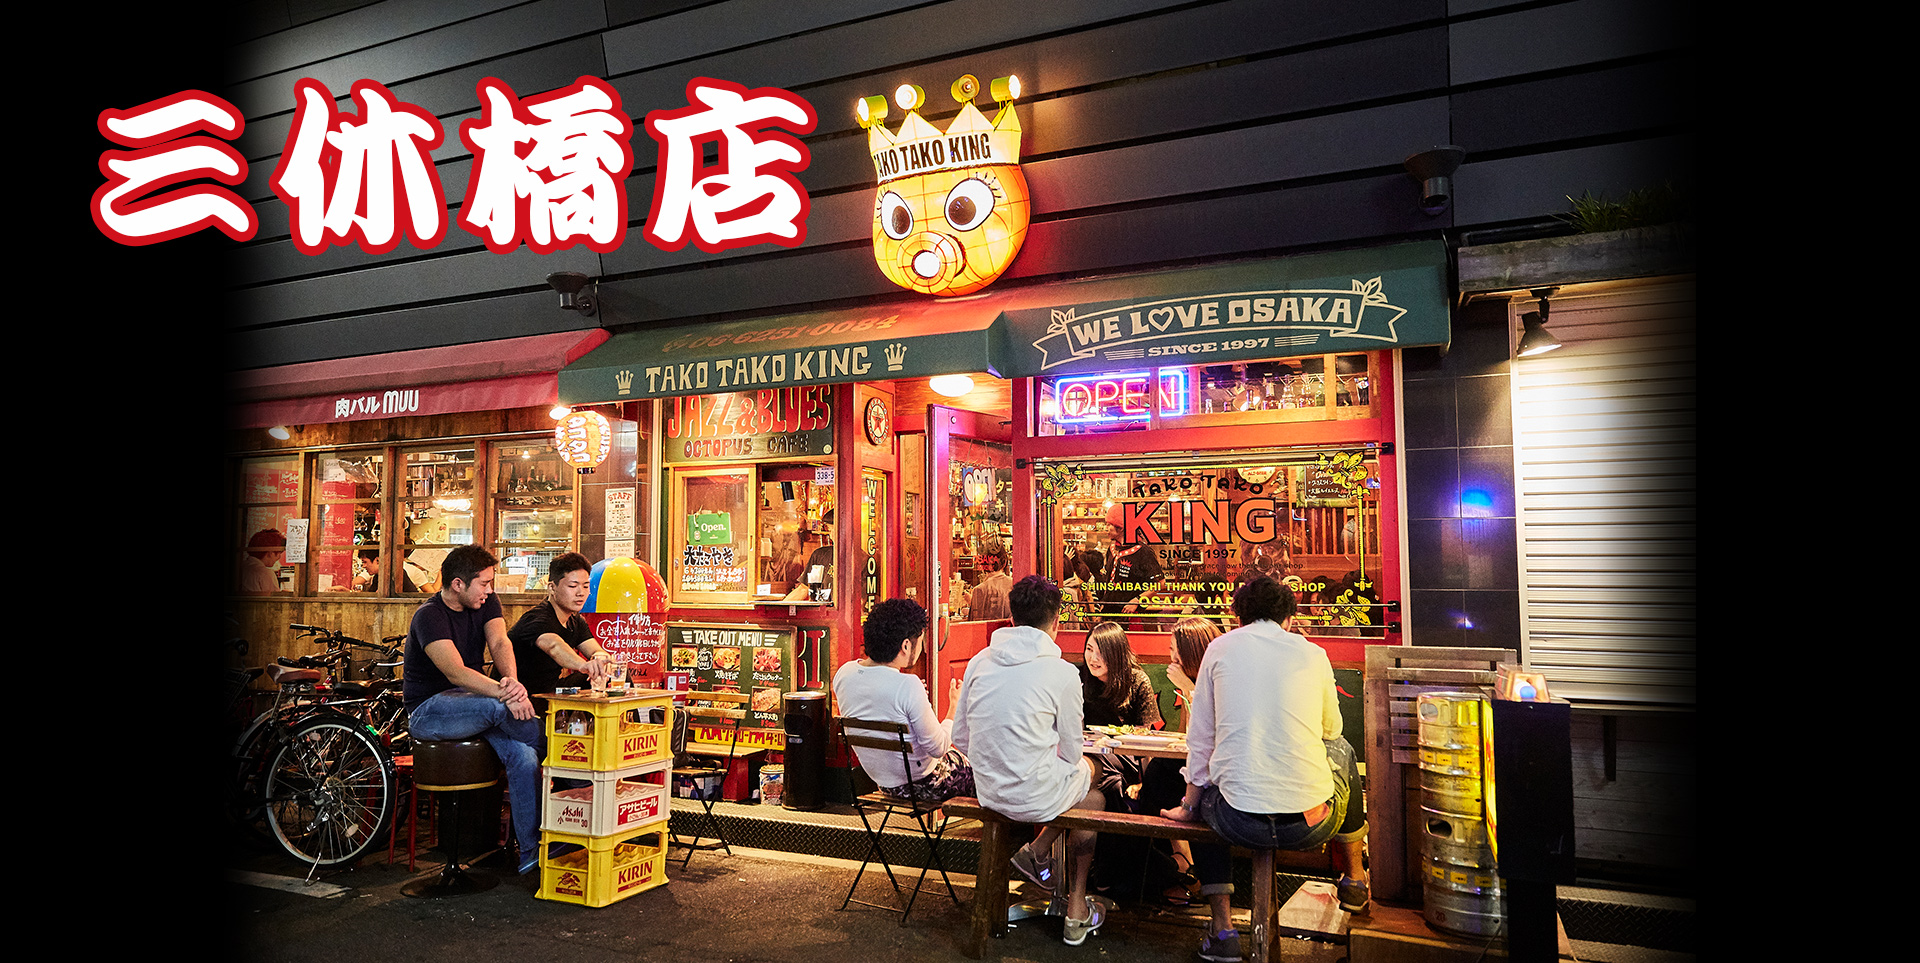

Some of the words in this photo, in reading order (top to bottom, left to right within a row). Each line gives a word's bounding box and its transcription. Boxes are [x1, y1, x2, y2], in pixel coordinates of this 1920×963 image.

[899, 139, 946, 172] TAKO
[948, 132, 992, 164] KING
[1071, 314, 1123, 346] WE
[1227, 296, 1354, 325] OSAKA
[1147, 340, 1218, 358] SINCE
[1220, 336, 1271, 352] 1997
[645, 362, 710, 394] TAKO
[715, 353, 787, 388] TAKO
[793, 345, 872, 382] KING
[335, 396, 381, 419] 肉バル
[382, 389, 420, 414] MUU
[1062, 376, 1176, 418] OPEN
[554, 425, 571, 462] キング
[567, 416, 592, 463] タコタコ
[684, 437, 754, 459] OCTOPUS
[816, 470, 834, 480] 338-5
[608, 492, 633, 502] STAFF
[1132, 477, 1193, 499] TAKO
[1200, 474, 1264, 495] TAKO
[700, 522, 727, 533] Open.
[1122, 498, 1278, 545] KING
[866, 478, 877, 613] WELCOME
[1158, 548, 1201, 560] SINCE
[1204, 547, 1237, 560] 1997
[1081, 582, 1162, 593] SHINSAIBASHI
[1165, 582, 1206, 592] THANK
[1209, 582, 1235, 592] YOU
[1290, 582, 1326, 592] SHOP
[1138, 596, 1194, 609] OSAKA
[1203, 598, 1234, 609] JAP
[693, 630, 718, 645] TAKE
[719, 631, 737, 646] OUT
[738, 631, 763, 647] MENU
[623, 734, 658, 753] KIRIN
[562, 805, 584, 818] Asahi
[619, 797, 658, 816] アサヒビール
[618, 860, 653, 885] KIRIN
